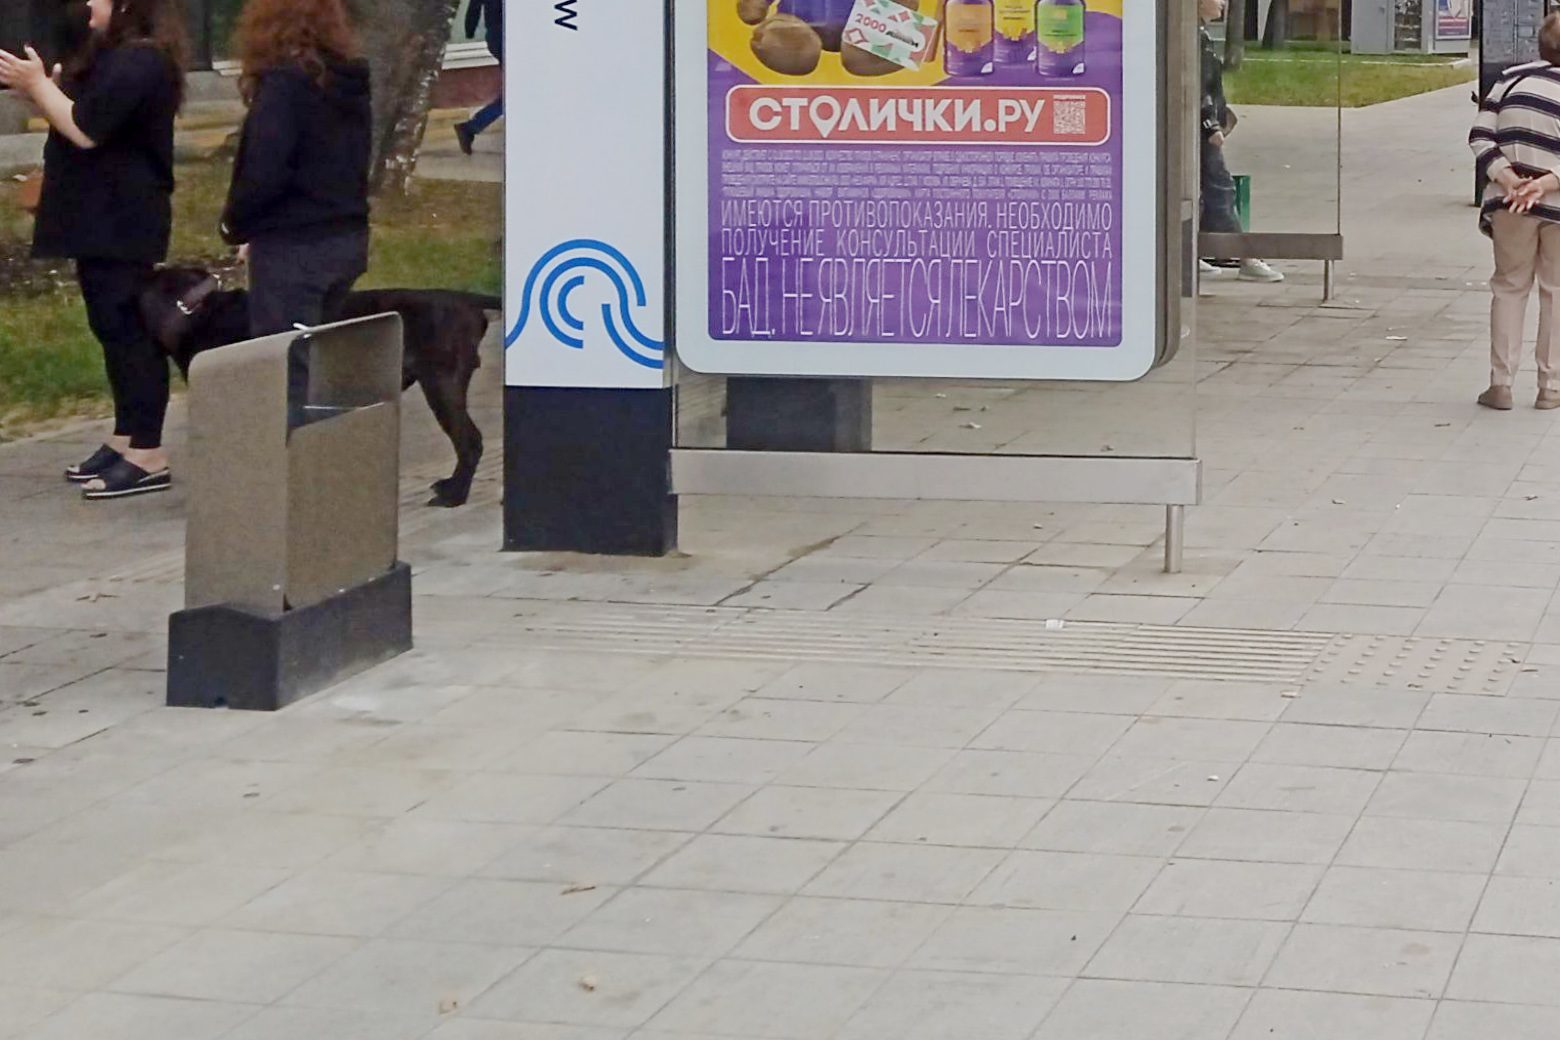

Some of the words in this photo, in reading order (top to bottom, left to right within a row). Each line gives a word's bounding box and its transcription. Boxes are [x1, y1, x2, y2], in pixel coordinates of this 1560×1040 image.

[855, 13, 887, 33] 2000
[749, 95, 1045, 137] СТОЛИЧКИ.РУ
[721, 199, 803, 227] ИМЕЮТСЯ
[808, 200, 992, 229] ПРОТИВОПОКАЗАНИЯ.
[996, 202, 1112, 231] НЕОБХОДИМО
[722, 228, 825, 256] ПОЛУЧЕНИЕ
[836, 229, 975, 259] КОНСУЛЬТАЦИИ
[987, 230, 1112, 259] СПЕЦИАЛИСТА
[722, 257, 775, 338] БАД.
[782, 257, 813, 336] НЕ
[818, 258, 941, 338] ЯВЛЯЕТСЯ
[945, 259, 1112, 339] ЛЕКАРСТВОМ
